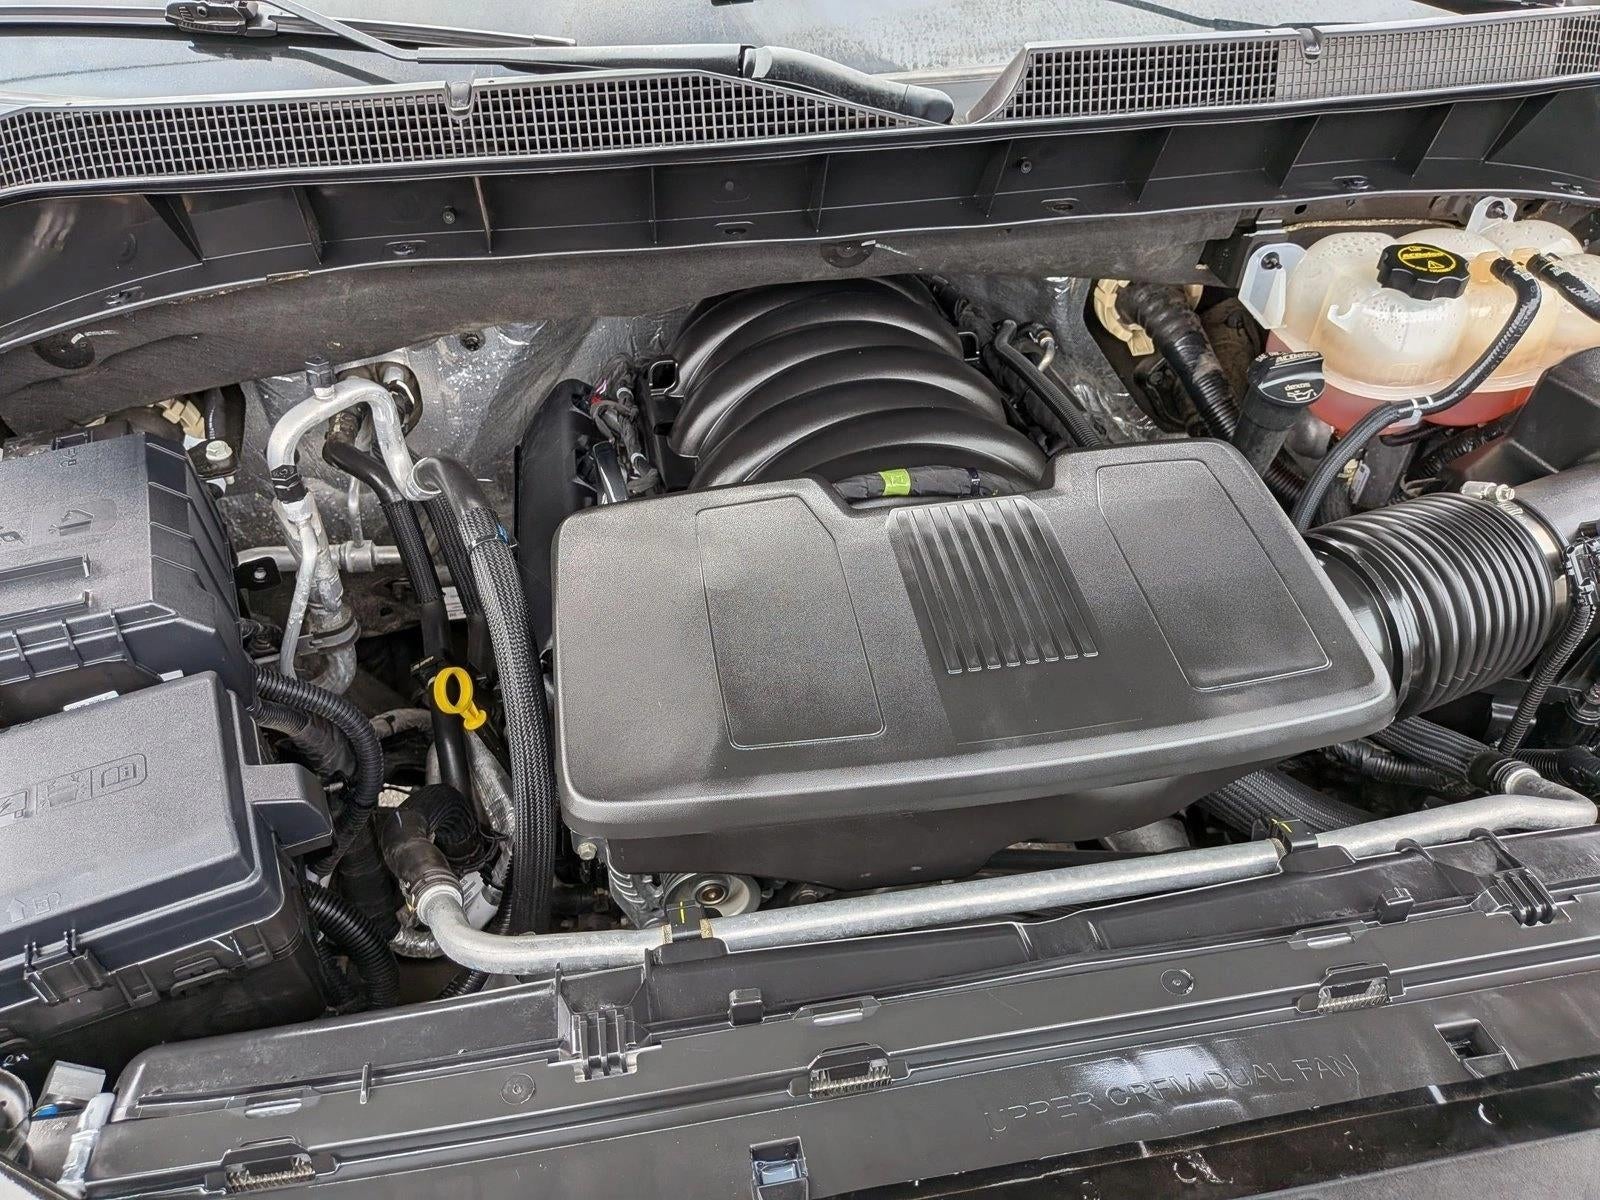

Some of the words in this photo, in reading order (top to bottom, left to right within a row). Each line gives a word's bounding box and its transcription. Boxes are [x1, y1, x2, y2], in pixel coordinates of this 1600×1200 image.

[1275, 351, 1320, 365] ACDelco
[984, 1092, 1102, 1132] UPPER
[1203, 1062, 1295, 1090] DUAL
[1292, 1053, 1360, 1081] FAN
